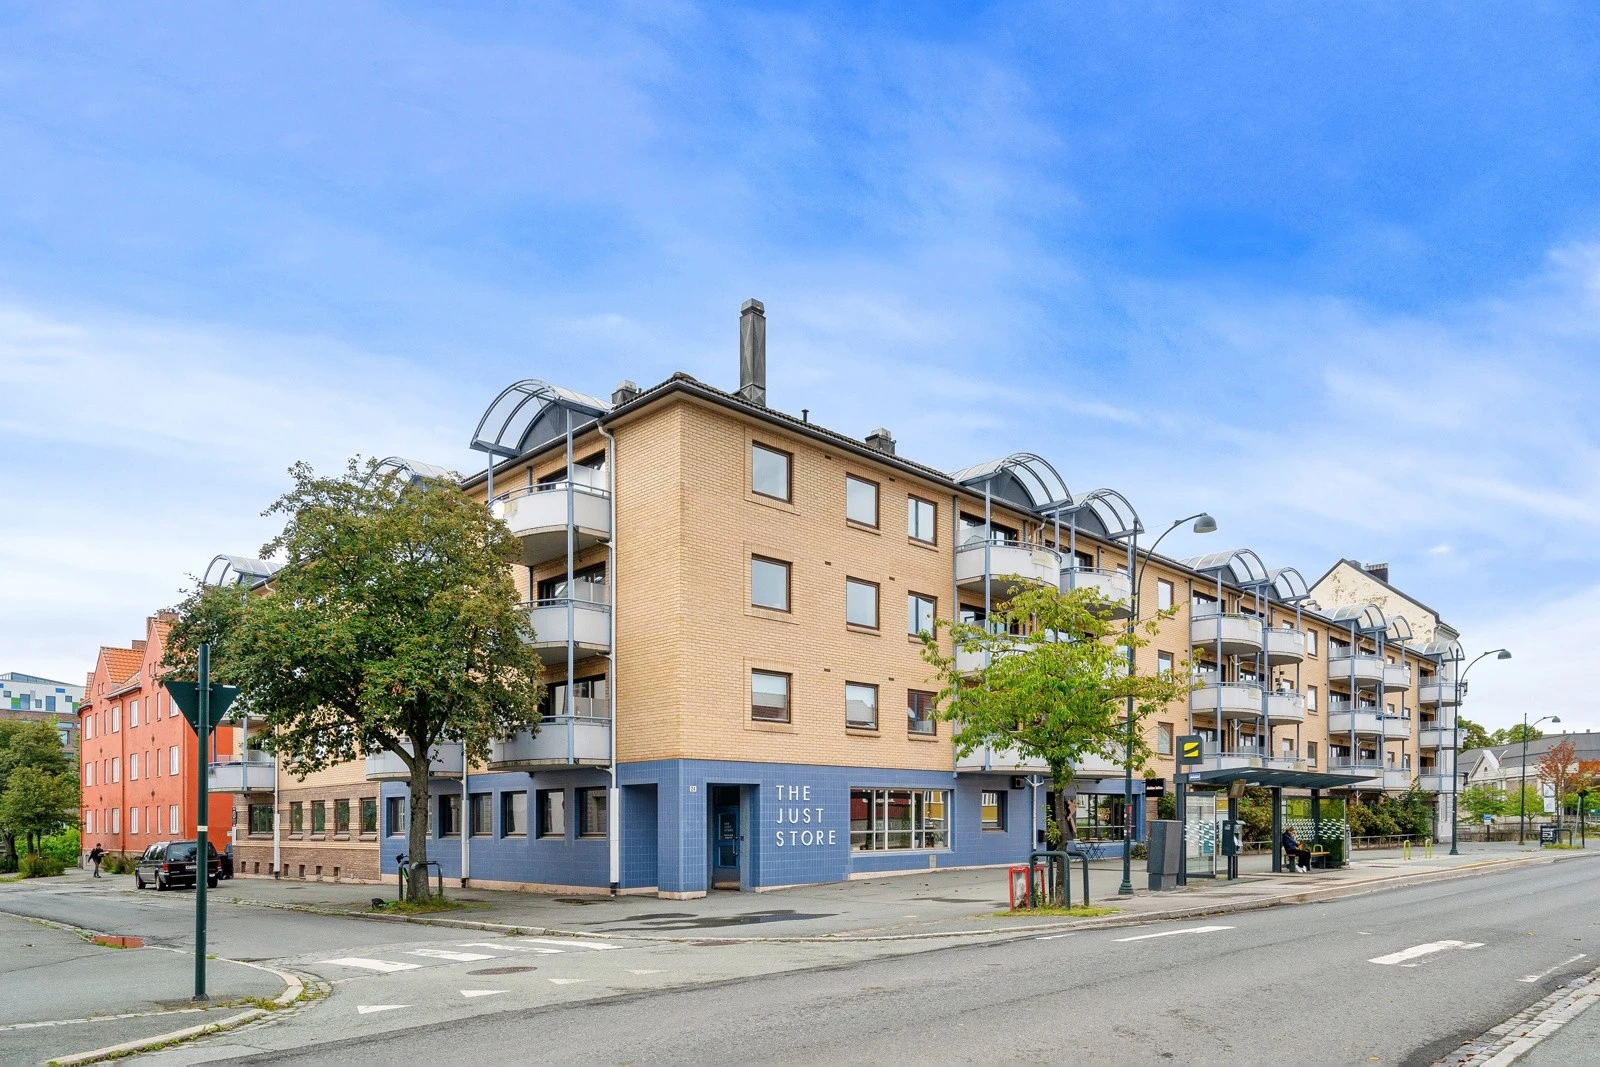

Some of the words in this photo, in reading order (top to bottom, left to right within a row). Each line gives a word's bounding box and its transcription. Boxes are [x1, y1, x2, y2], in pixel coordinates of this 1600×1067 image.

[776, 785, 811, 801] THE
[776, 808, 824, 824] JUST
[776, 830, 836, 847] STORE
